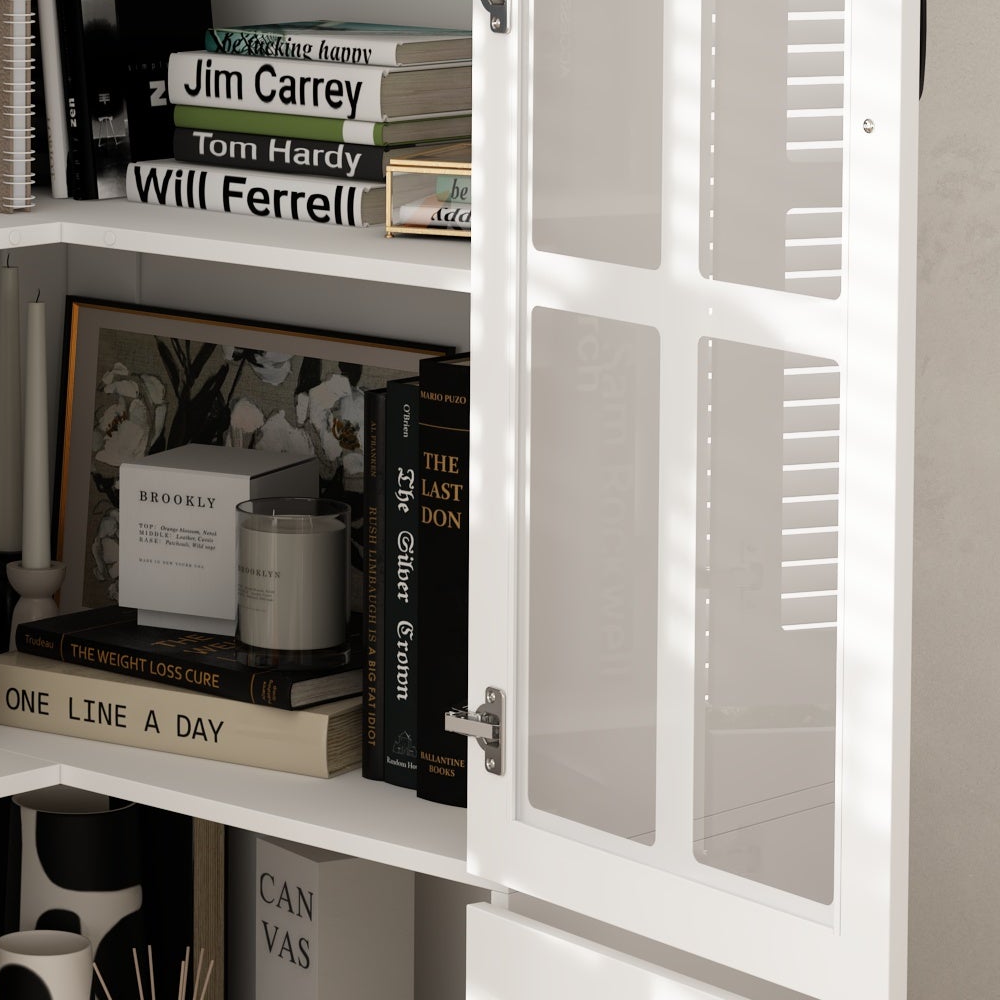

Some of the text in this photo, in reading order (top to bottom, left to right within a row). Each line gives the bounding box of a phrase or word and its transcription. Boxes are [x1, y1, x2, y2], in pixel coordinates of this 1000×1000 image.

[318, 40, 372, 64] happy
[184, 58, 243, 100] Jim
[254, 63, 363, 120] Carrey
[69, 97, 77, 128] zen
[193, 131, 362, 178] Tom Hardy
[134, 165, 207, 211] Will
[222, 175, 356, 226] Ferrell
[420, 390, 467, 405] MARIO PUZO
[403, 403, 411, 438] O'Brien
[423, 451, 459, 474] THE
[139, 490, 216, 509] BROOKLY
[394, 467, 415, 514] The
[421, 478, 463, 502] LAST
[421, 506, 462, 530] DON
[24, 634, 54, 649] Trudeau
[368, 506, 377, 747] RUSH LIMBAUGH IS A BIG FAT IDIOT
[70, 643, 220, 689] THE WEIGHT LOSS CURE
[5, 687, 224, 743] ONE LINE A DAY
[420, 751, 465, 778] BALLANTINE BOOKS
[259, 871, 314, 922] CAN
[261, 920, 311, 970] VAS
